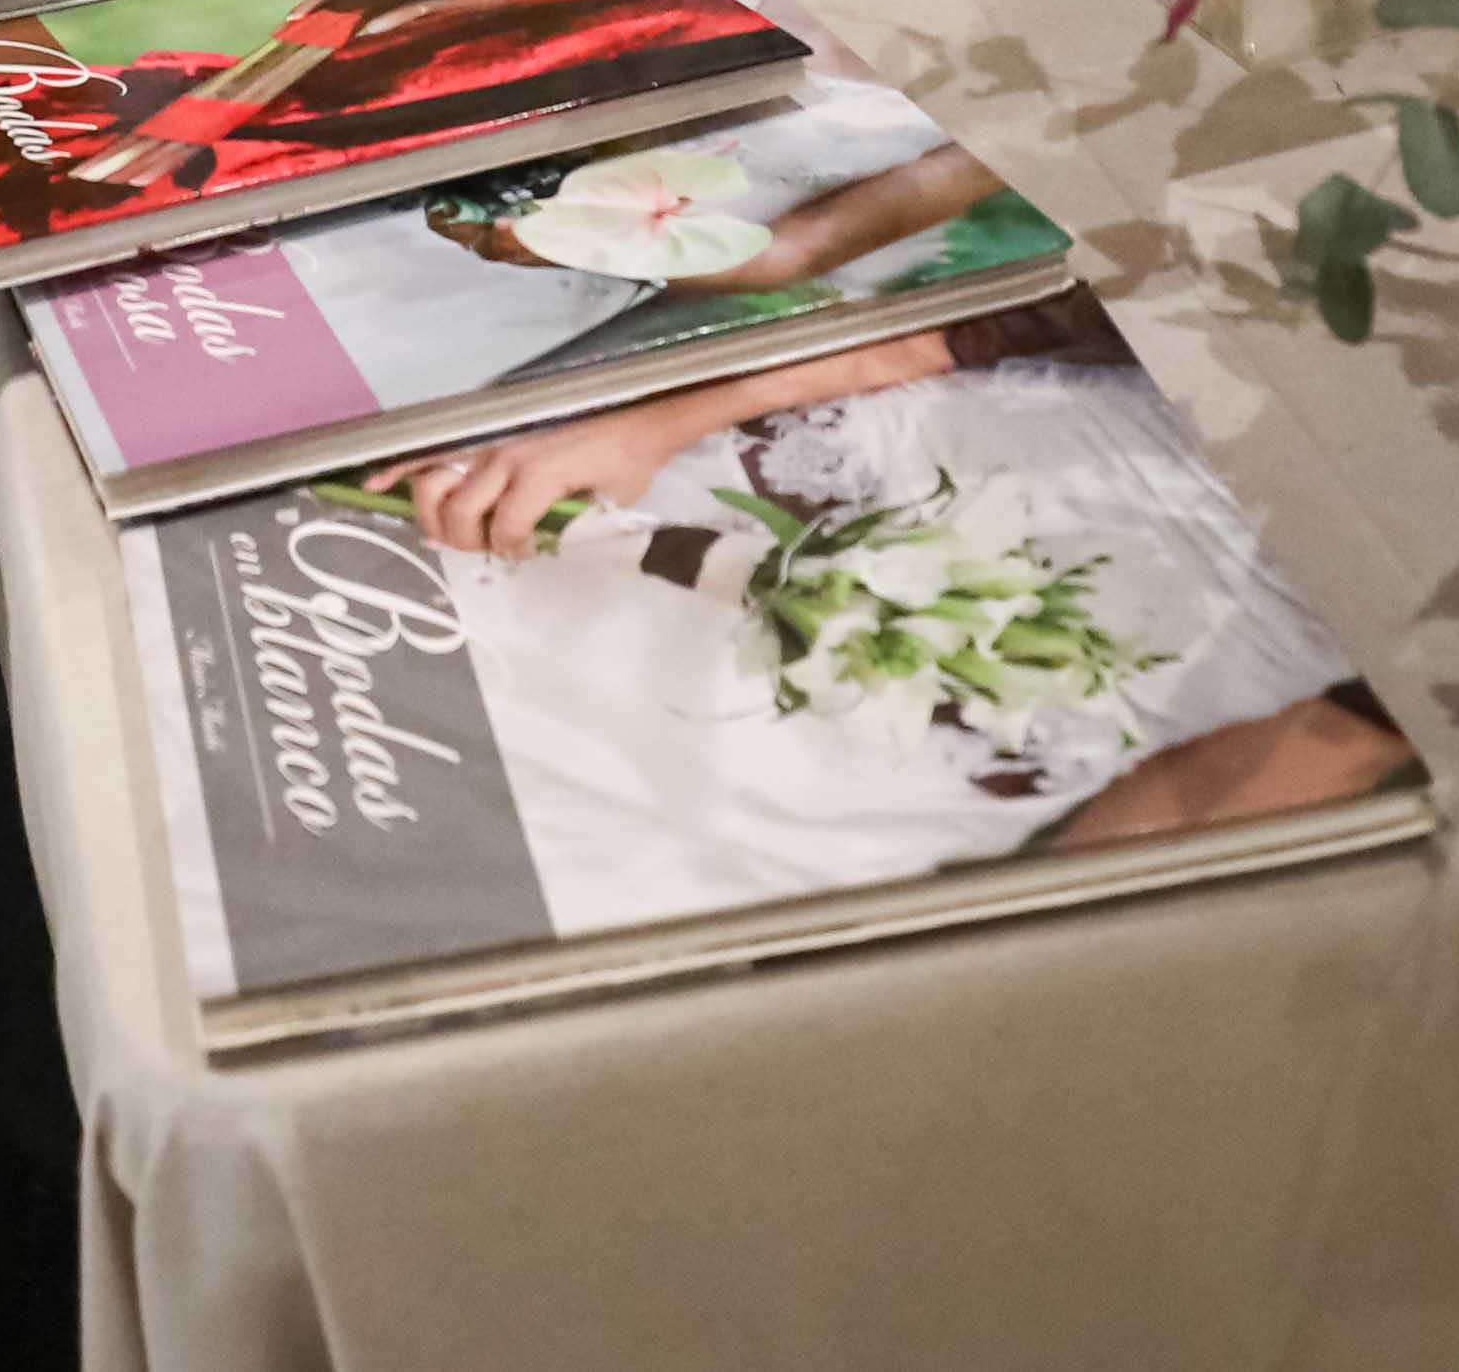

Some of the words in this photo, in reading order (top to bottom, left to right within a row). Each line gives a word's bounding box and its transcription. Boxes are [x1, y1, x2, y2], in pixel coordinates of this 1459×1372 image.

[230, 531, 263, 576] en
[287, 520, 468, 832] Bodas
[241, 580, 374, 838] blanco
